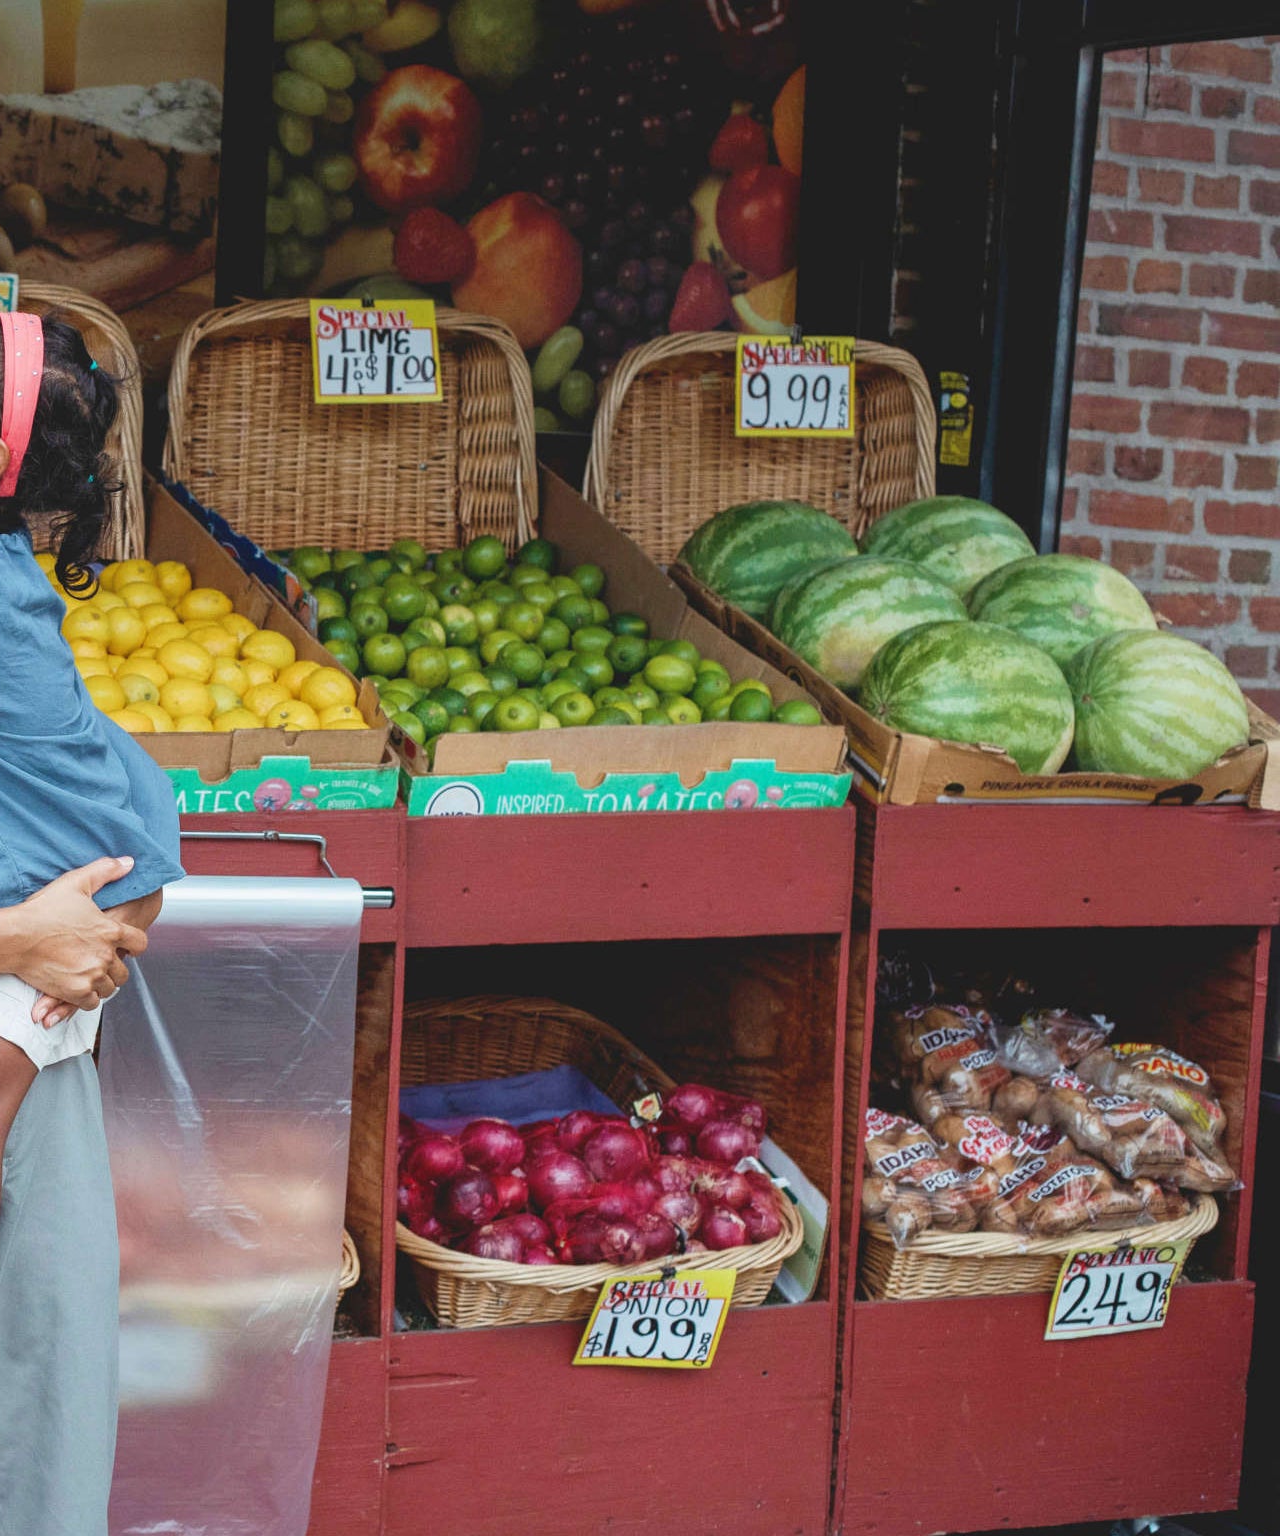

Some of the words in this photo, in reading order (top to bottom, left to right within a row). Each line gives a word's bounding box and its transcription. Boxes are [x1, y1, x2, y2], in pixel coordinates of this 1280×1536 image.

[317, 306, 412, 339] SPECIAL
[341, 328, 410, 355] LIME
[326, 355, 348, 393] 4
[746, 372, 831, 429] 9.99
[176, 789, 251, 813] ATES
[981, 780, 1055, 791] PINEAPPLE
[611, 1297, 710, 1317] ONION
[1055, 1271, 1161, 1325] 2.49
[1155, 1277, 1171, 1321] BAG
[587, 1316, 696, 1361] $1.99
[692, 1332, 712, 1367] BAG
